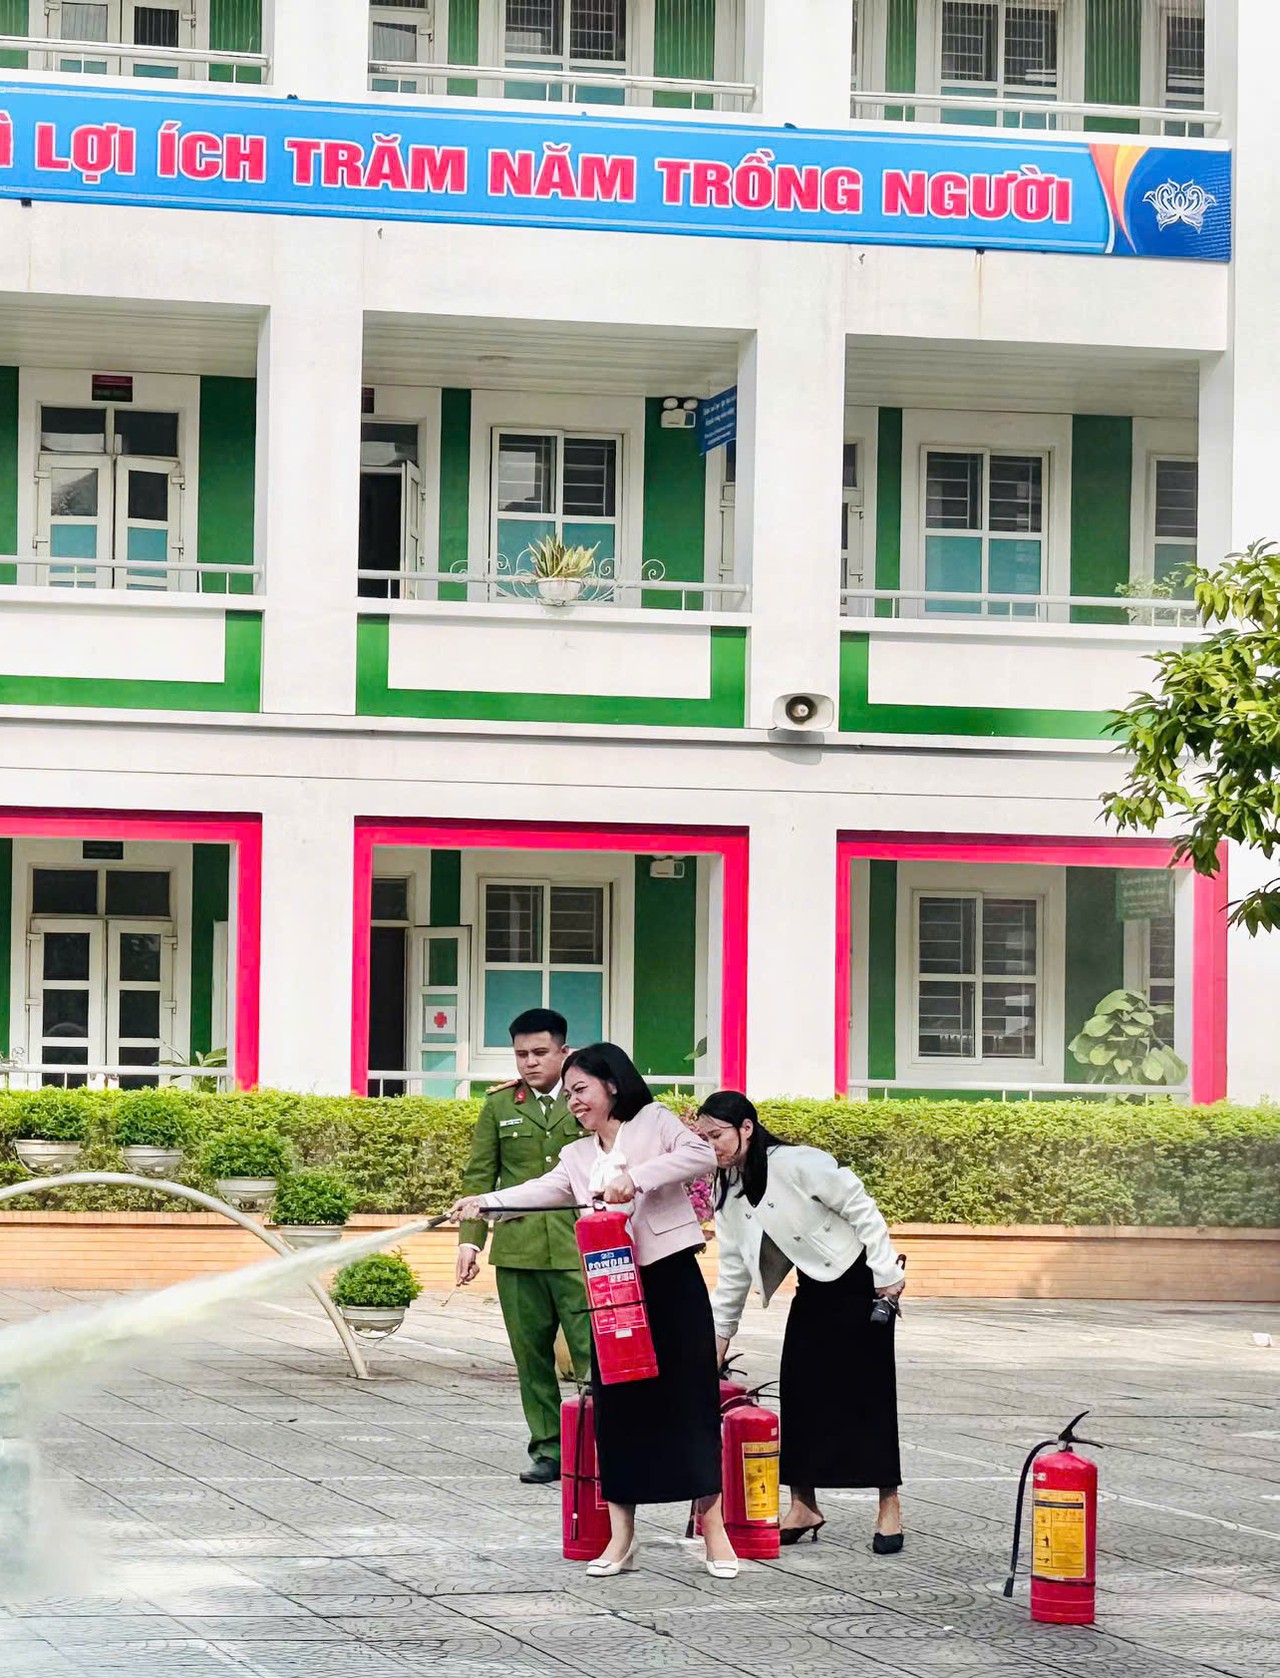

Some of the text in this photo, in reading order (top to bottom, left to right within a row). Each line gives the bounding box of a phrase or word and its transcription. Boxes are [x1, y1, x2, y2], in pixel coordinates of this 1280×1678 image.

[35, 121, 136, 184] LỢI
[157, 119, 267, 184] ÍCH
[285, 133, 468, 195] TRĂM
[489, 142, 637, 202] NĂM
[656, 148, 862, 217] TRỒNG
[880, 166, 1073, 225] NGƯỜI
